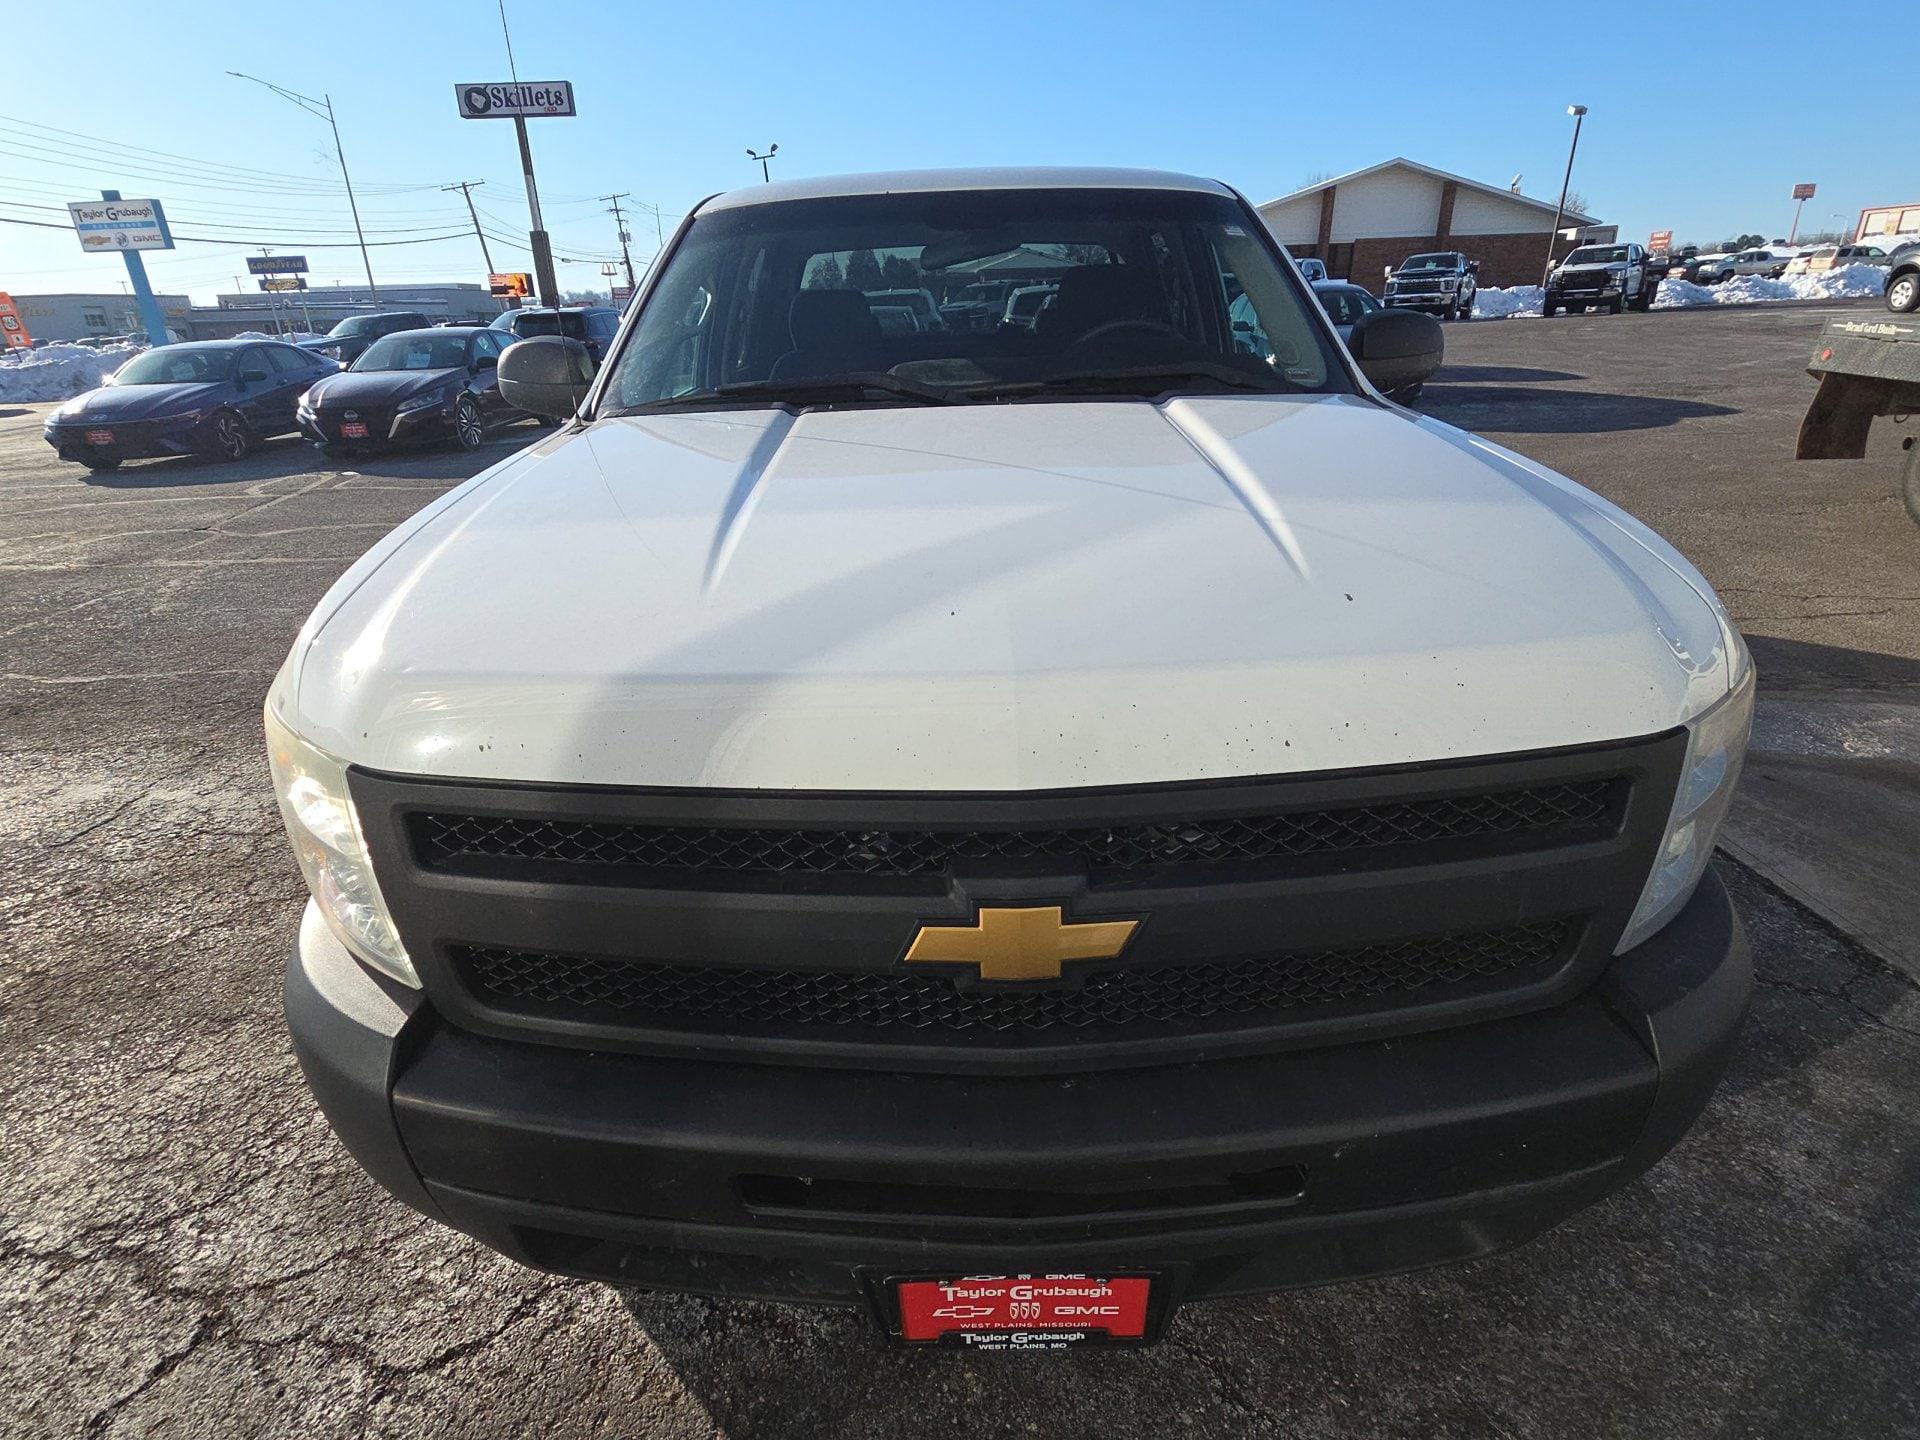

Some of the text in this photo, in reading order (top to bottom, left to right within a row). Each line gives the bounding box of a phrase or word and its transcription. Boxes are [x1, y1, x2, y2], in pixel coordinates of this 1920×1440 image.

[490, 86, 564, 109] Skillets
[72, 206, 152, 222] Taylor Grubaugh
[132, 234, 163, 242] GMC
[939, 1285, 1113, 1301] Taylor Grubaugh
[1054, 1306, 1120, 1315] GMC
[960, 1332, 1086, 1344] Taylor Grubaugh
